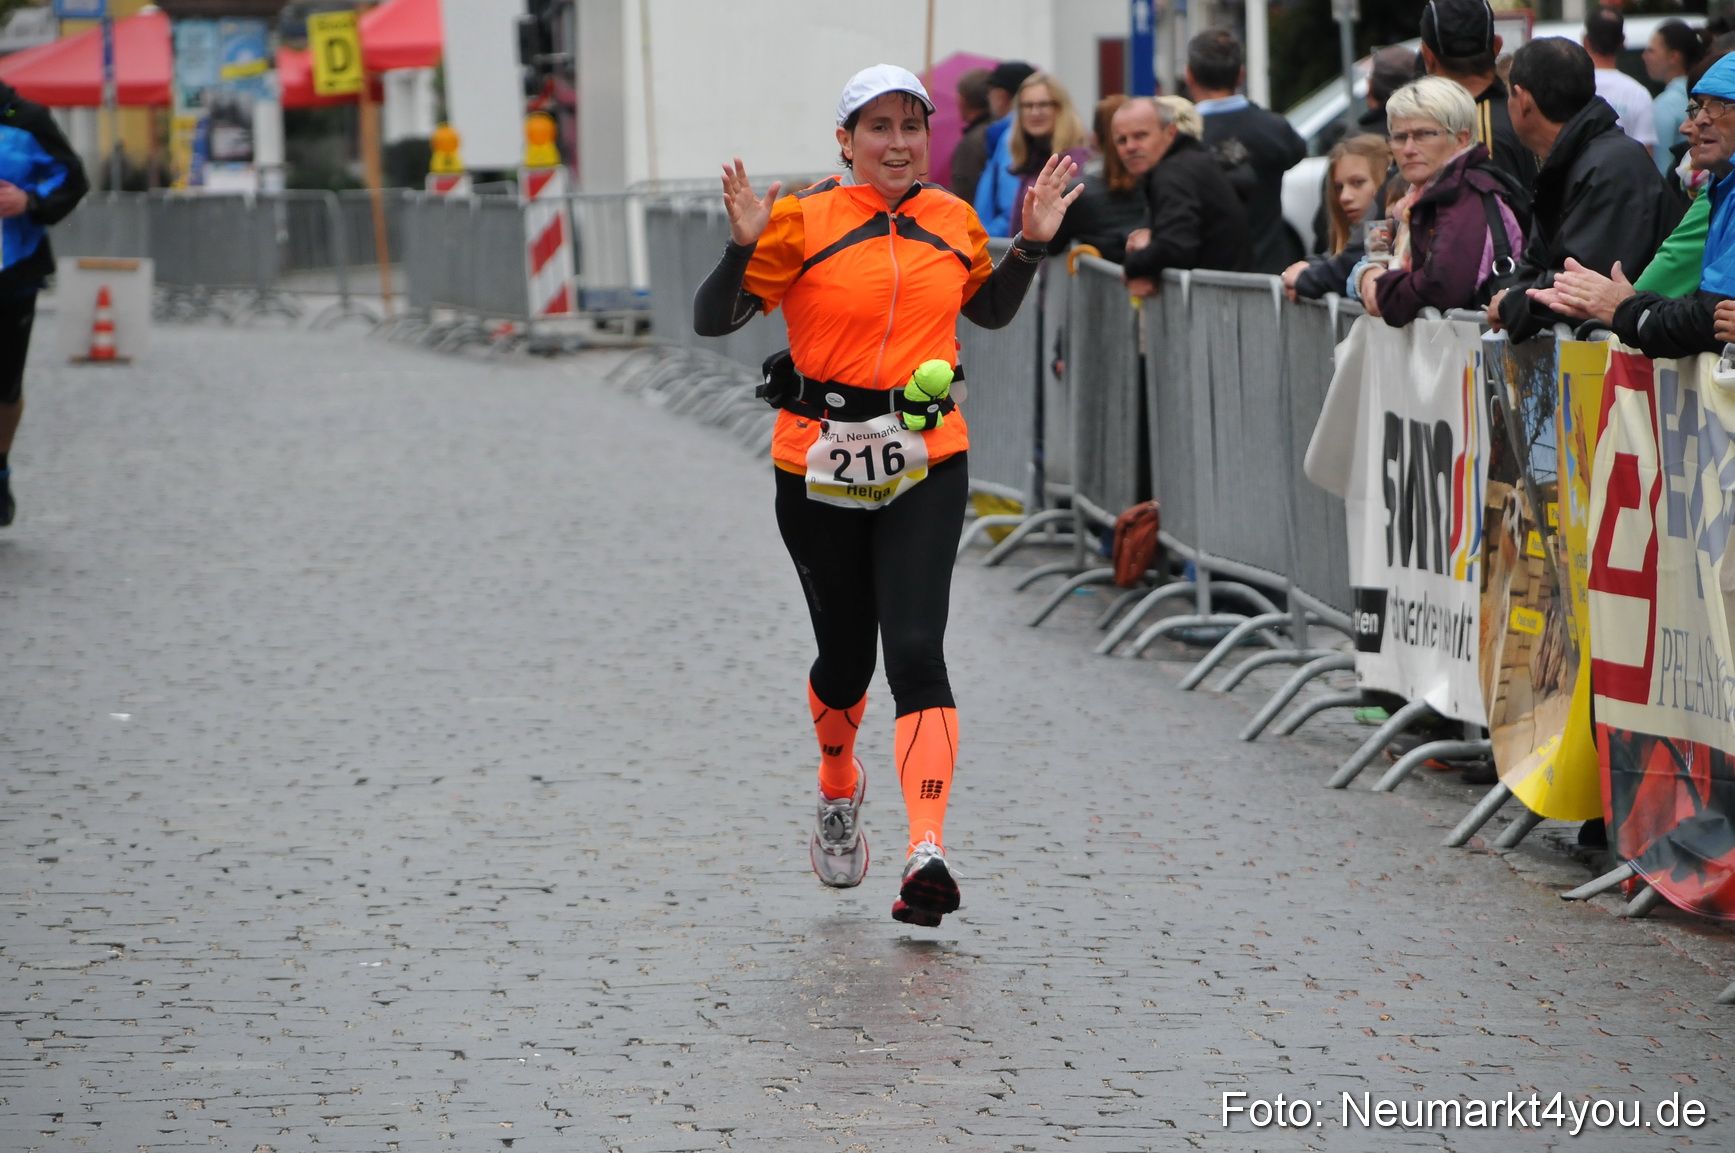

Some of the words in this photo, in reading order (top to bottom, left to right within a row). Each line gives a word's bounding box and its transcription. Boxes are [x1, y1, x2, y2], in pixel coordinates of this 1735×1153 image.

[325, 36, 352, 73] D
[847, 424, 899, 443] Neumarkt
[829, 441, 905, 484] 216
[846, 485, 891, 501] Helga
